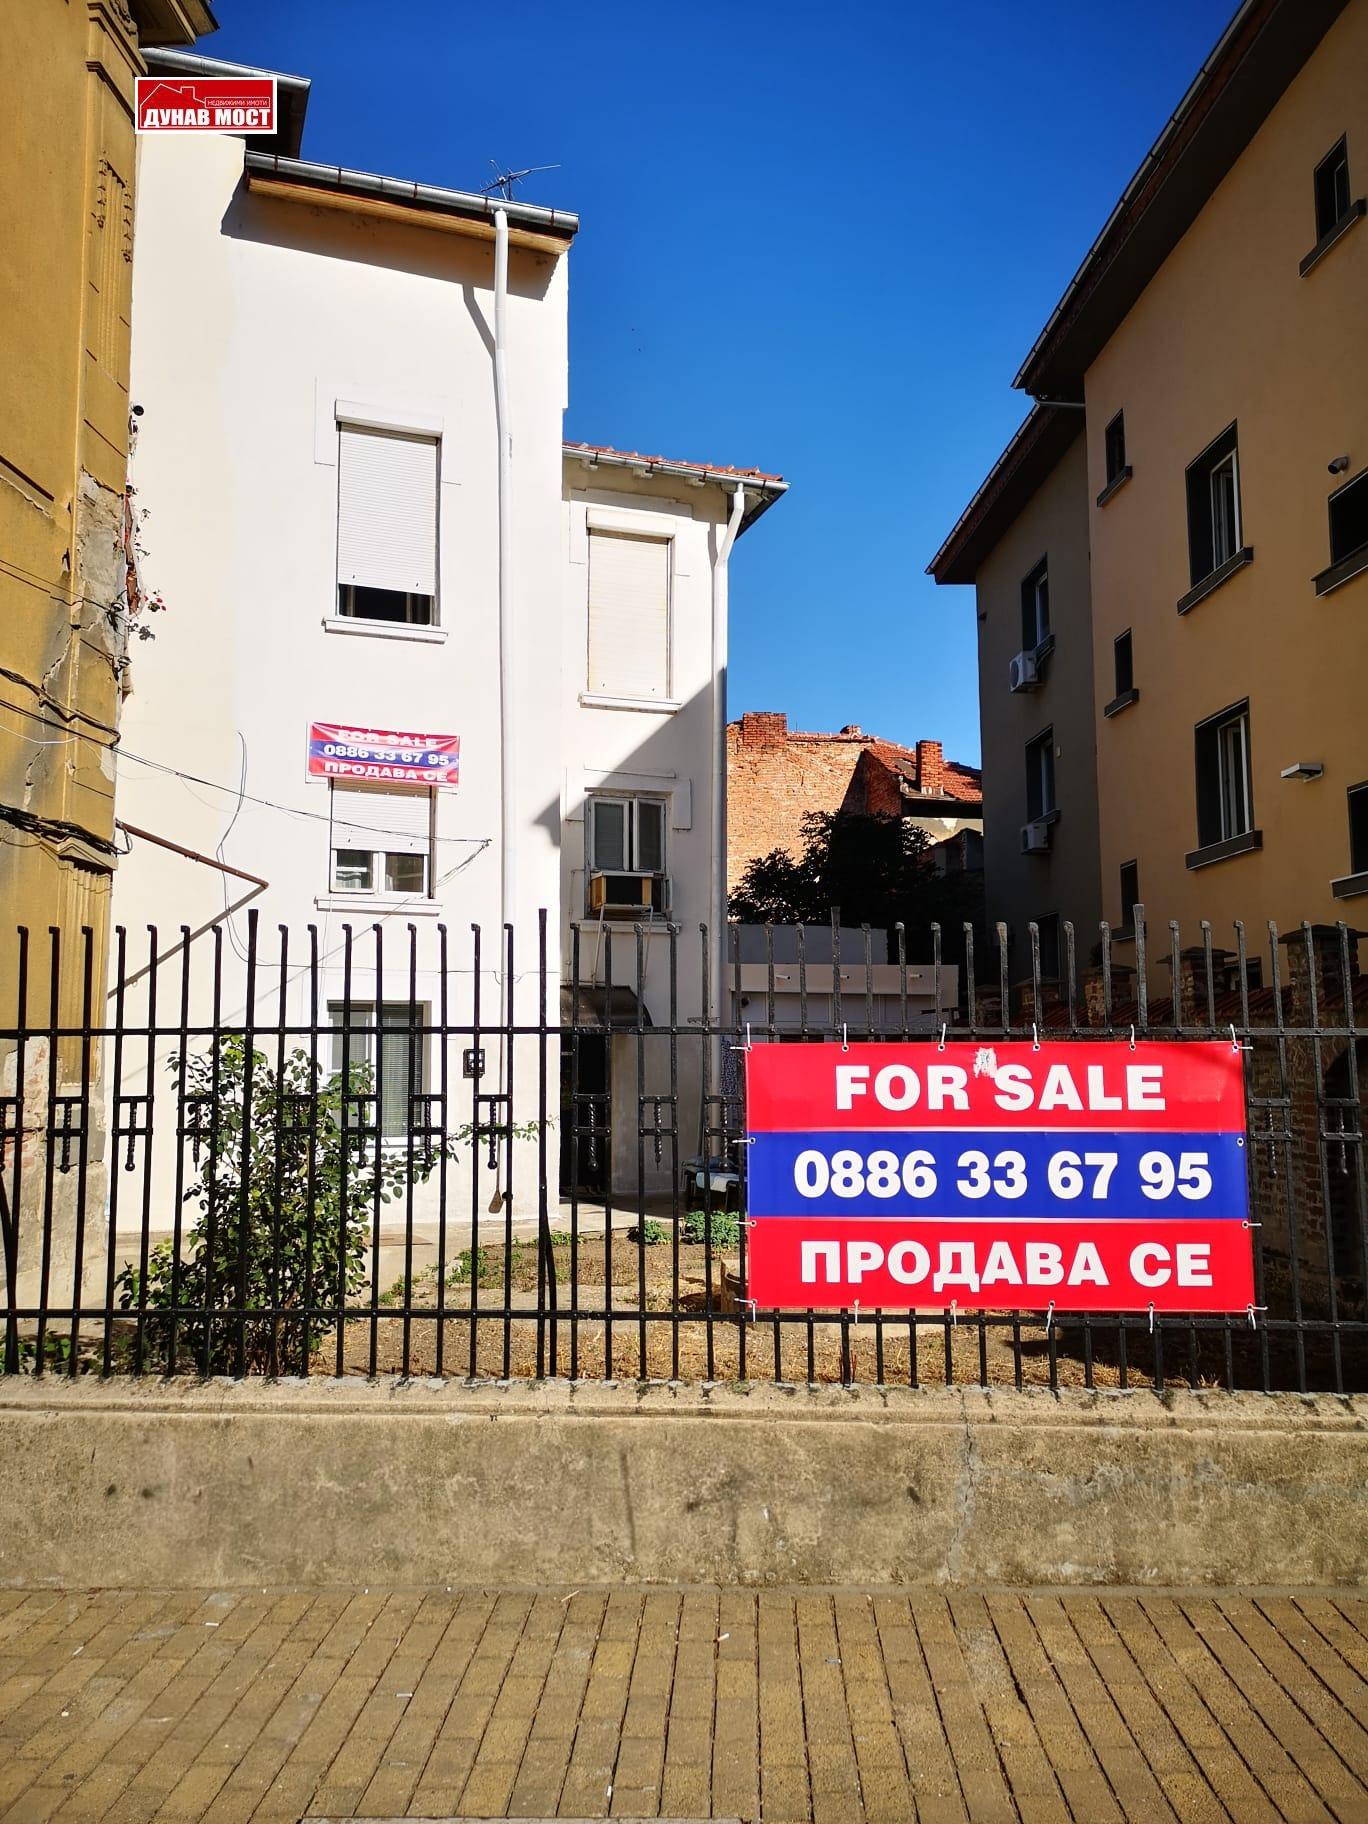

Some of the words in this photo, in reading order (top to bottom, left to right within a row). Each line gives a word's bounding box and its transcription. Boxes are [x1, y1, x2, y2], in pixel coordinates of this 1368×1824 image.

[323, 744, 369, 759] 0886
[374, 749, 396, 761] 33
[401, 752, 423, 763] 67
[427, 753, 449, 766] 95
[337, 729, 379, 743] FOR
[386, 734, 438, 748] SALE
[324, 761, 418, 779] ПРОДАВА
[422, 770, 448, 782] СЕ
[835, 1064, 970, 1111] FOR
[994, 1064, 1166, 1112] SALE
[793, 1149, 938, 1199] 0886
[956, 1150, 1028, 1199] 33
[1047, 1151, 1119, 1200] 67
[1138, 1151, 1213, 1201] 95
[800, 1240, 1109, 1293] ПРОДАВА
[1129, 1242, 1213, 1288] СЕ
